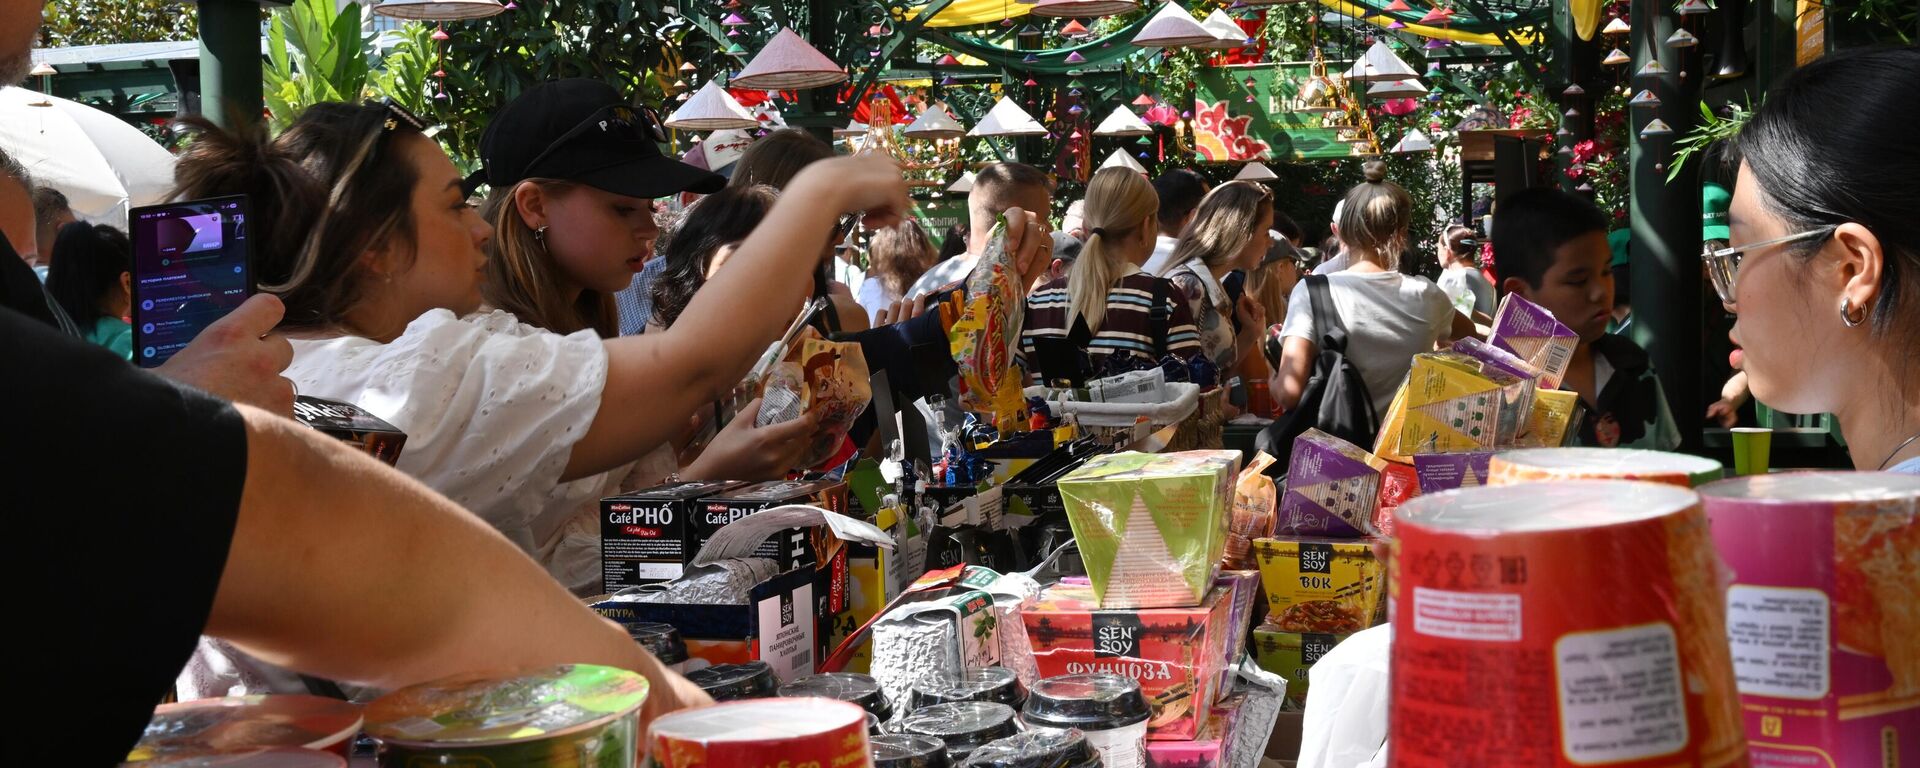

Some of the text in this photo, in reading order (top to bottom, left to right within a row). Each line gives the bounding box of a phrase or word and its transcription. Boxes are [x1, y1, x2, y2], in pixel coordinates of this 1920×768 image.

[609, 502, 673, 525] Café PHỐ
[705, 512, 728, 525] Café
[1303, 551, 1326, 560] SEN
[1303, 561, 1326, 571] SOY
[1299, 576, 1331, 589] ВОК
[1099, 626, 1132, 640] SEN
[1101, 640, 1133, 656] SOY
[1305, 643, 1329, 653] SEN
[1306, 653, 1325, 662] SO
[1066, 661, 1172, 681] ФУНЧОЗА
